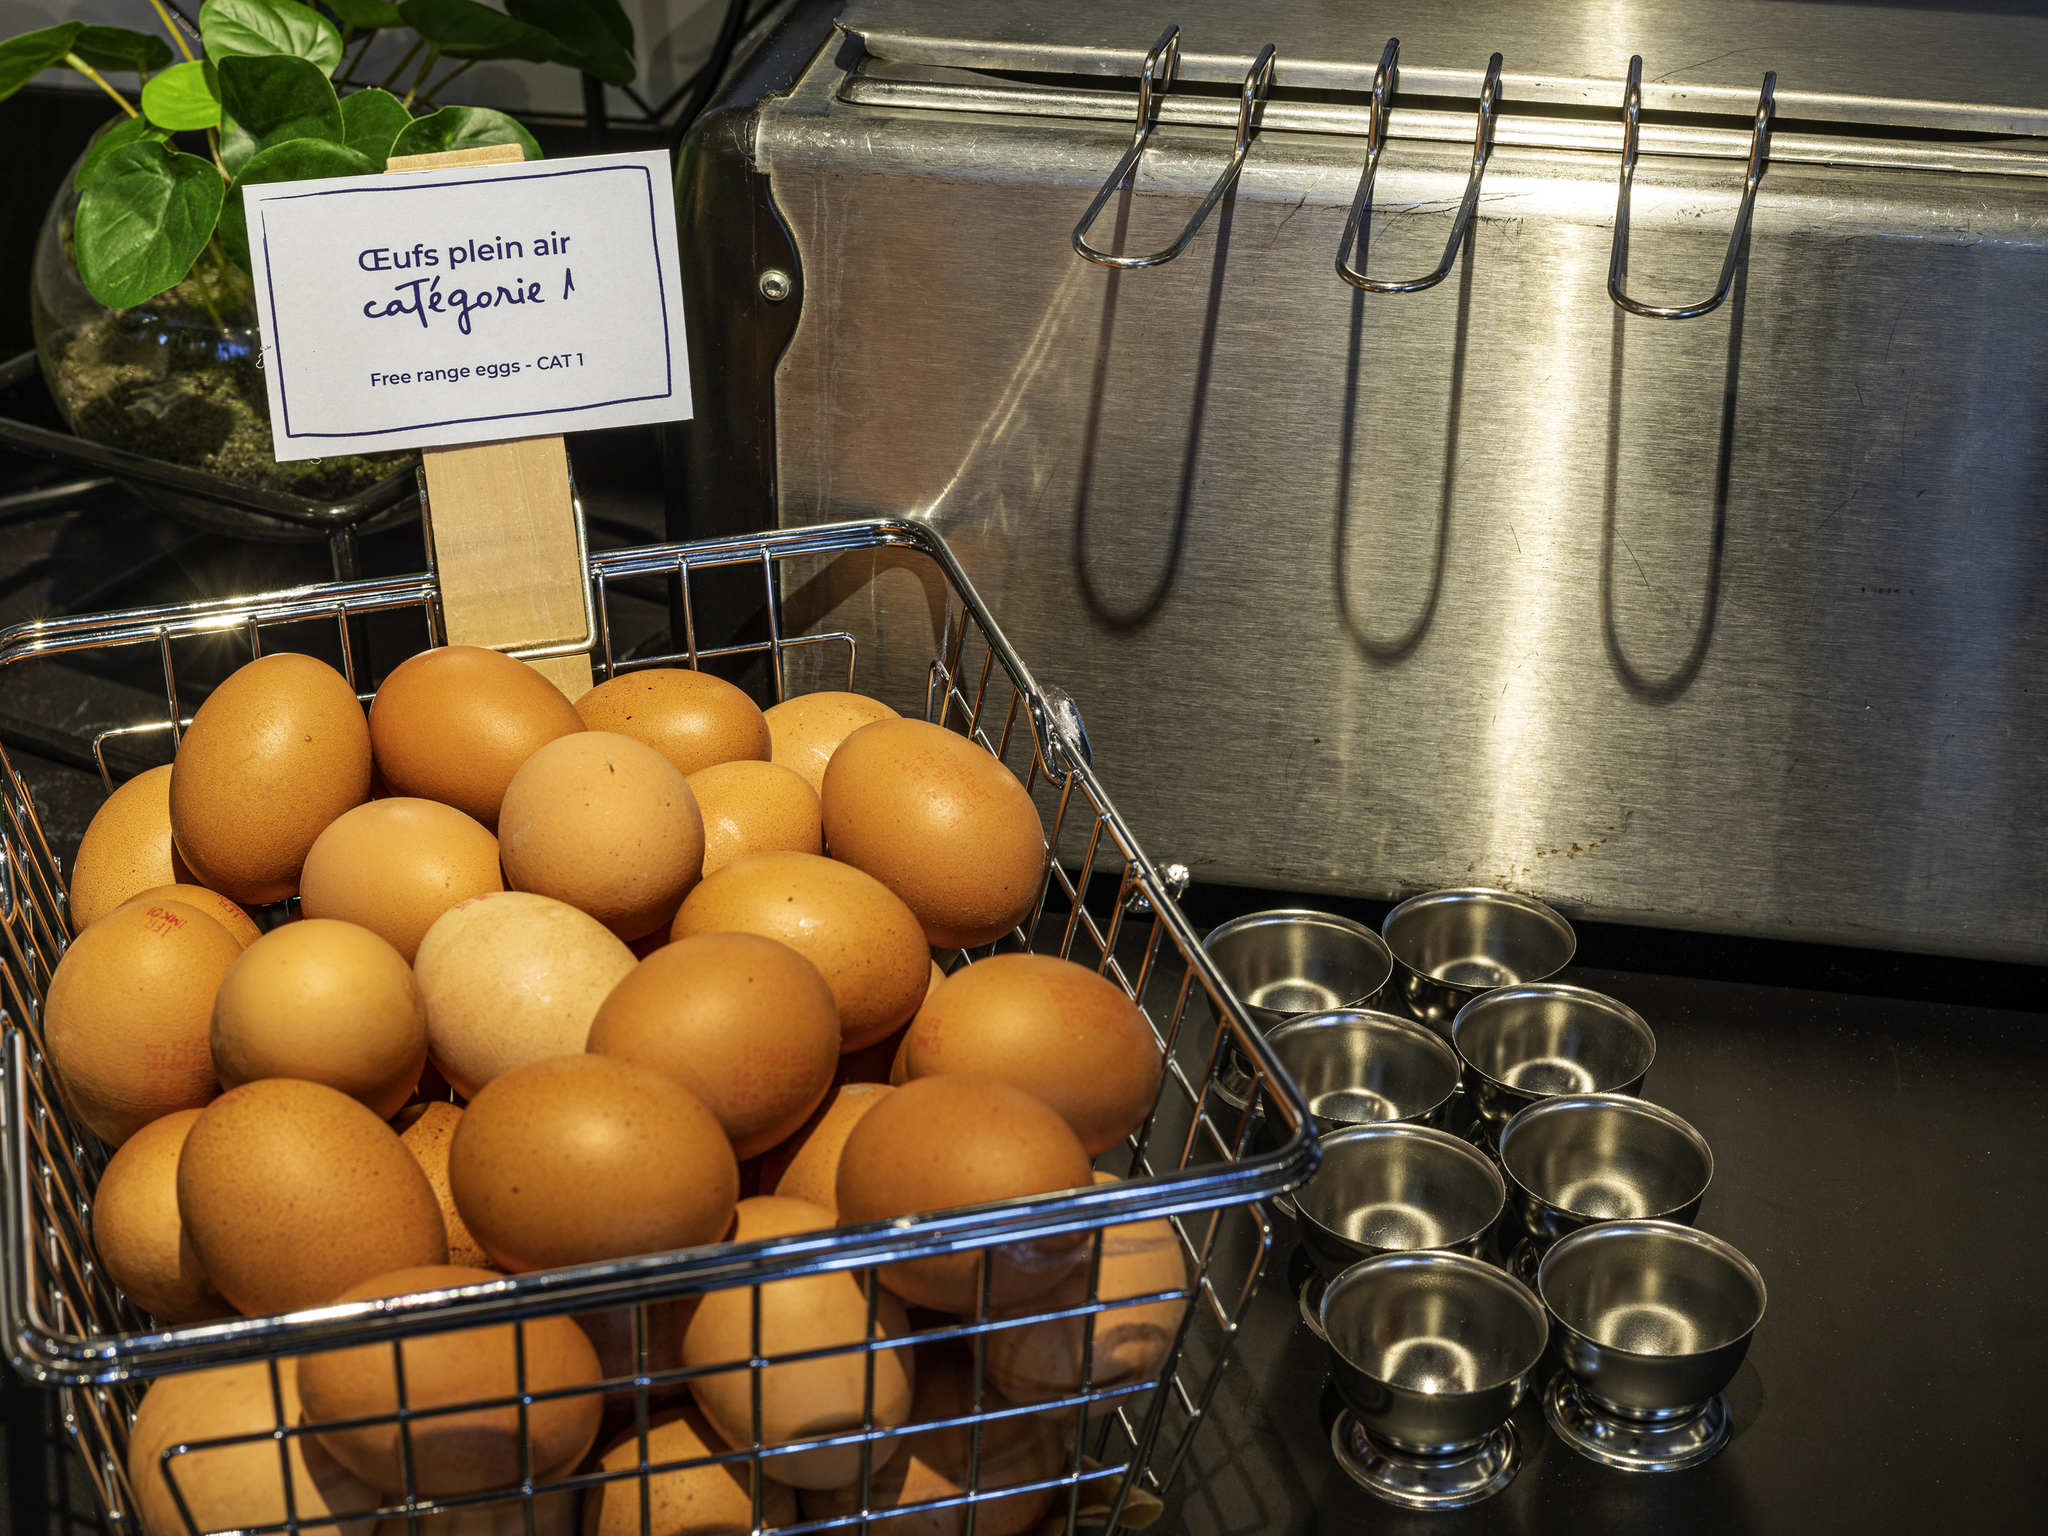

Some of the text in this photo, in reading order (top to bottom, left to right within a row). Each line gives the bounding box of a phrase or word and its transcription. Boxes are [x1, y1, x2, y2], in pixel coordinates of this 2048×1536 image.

[358, 230, 571, 272] Œufs plein air
[562, 267, 576, 301] 1
[370, 371, 412, 387] Free
[416, 367, 471, 383] range
[475, 361, 523, 379] eggs
[536, 353, 573, 371] CAT
[577, 352, 584, 367] 1
